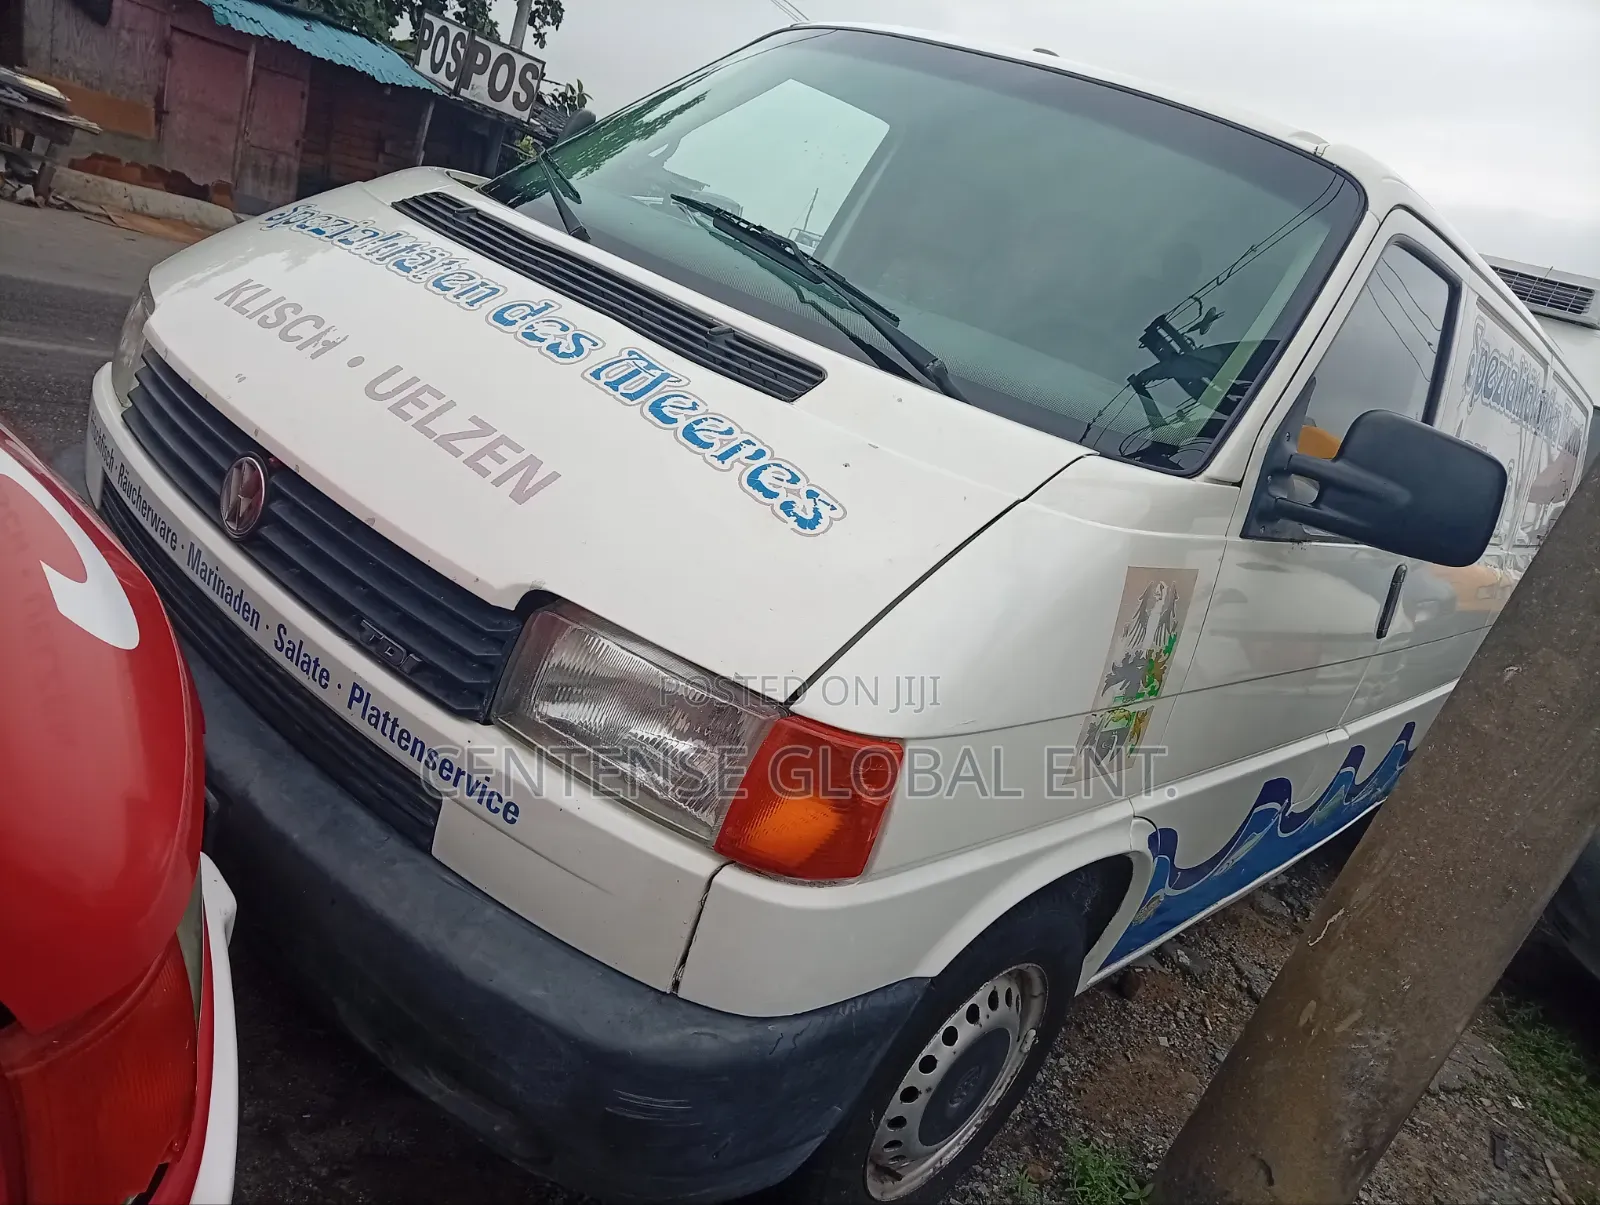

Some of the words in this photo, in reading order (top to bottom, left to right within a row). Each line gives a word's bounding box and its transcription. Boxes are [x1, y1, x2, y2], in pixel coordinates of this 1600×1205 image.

[414, 18, 467, 82] POS
[460, 39, 541, 112] POS
[485, 299, 606, 365] des
[364, 365, 561, 506] UELZEN
[117, 461, 179, 552] Räucherware
[186, 541, 260, 632] Marinaden
[273, 623, 330, 690] Salate
[347, 681, 521, 826] Plattenservice
